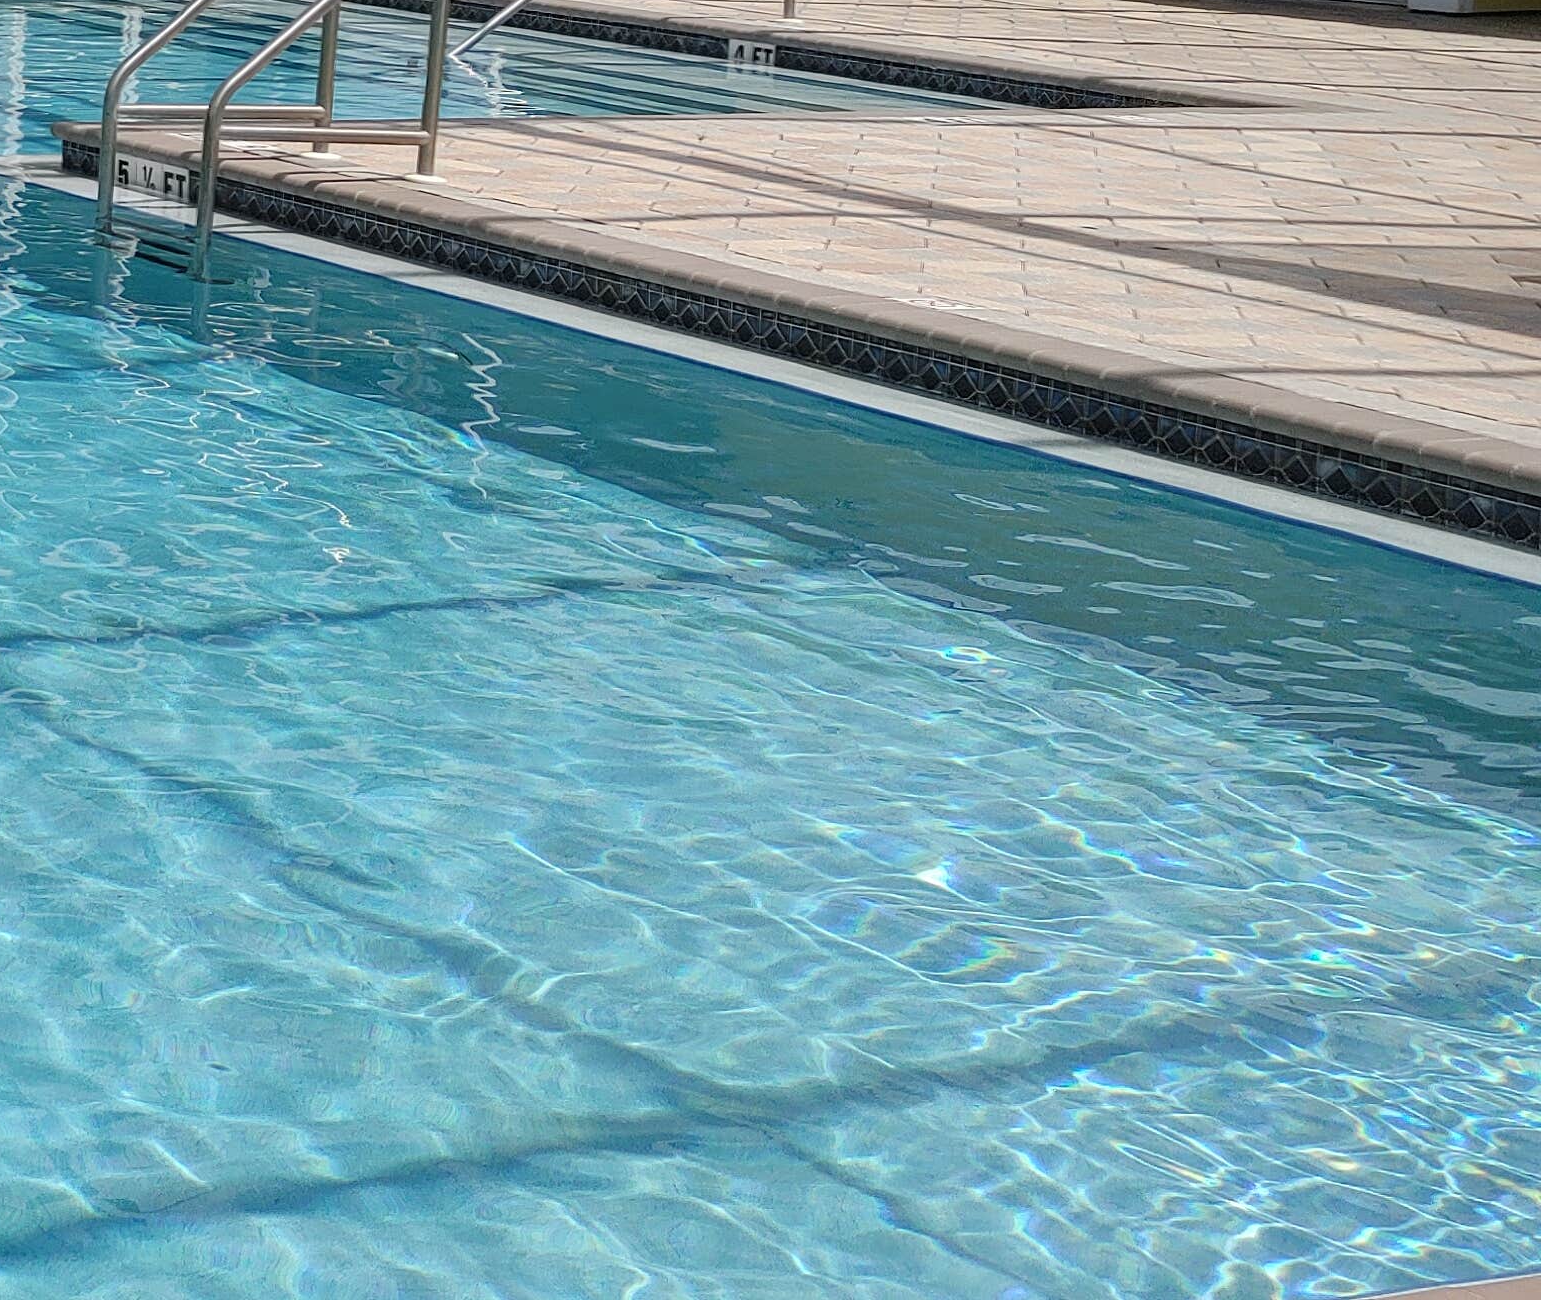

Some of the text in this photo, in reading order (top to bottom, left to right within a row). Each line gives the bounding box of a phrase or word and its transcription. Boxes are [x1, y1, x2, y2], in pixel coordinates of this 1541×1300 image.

[753, 47, 774, 64] FT
[118, 159, 129, 185] 5
[164, 171, 186, 198] FT
